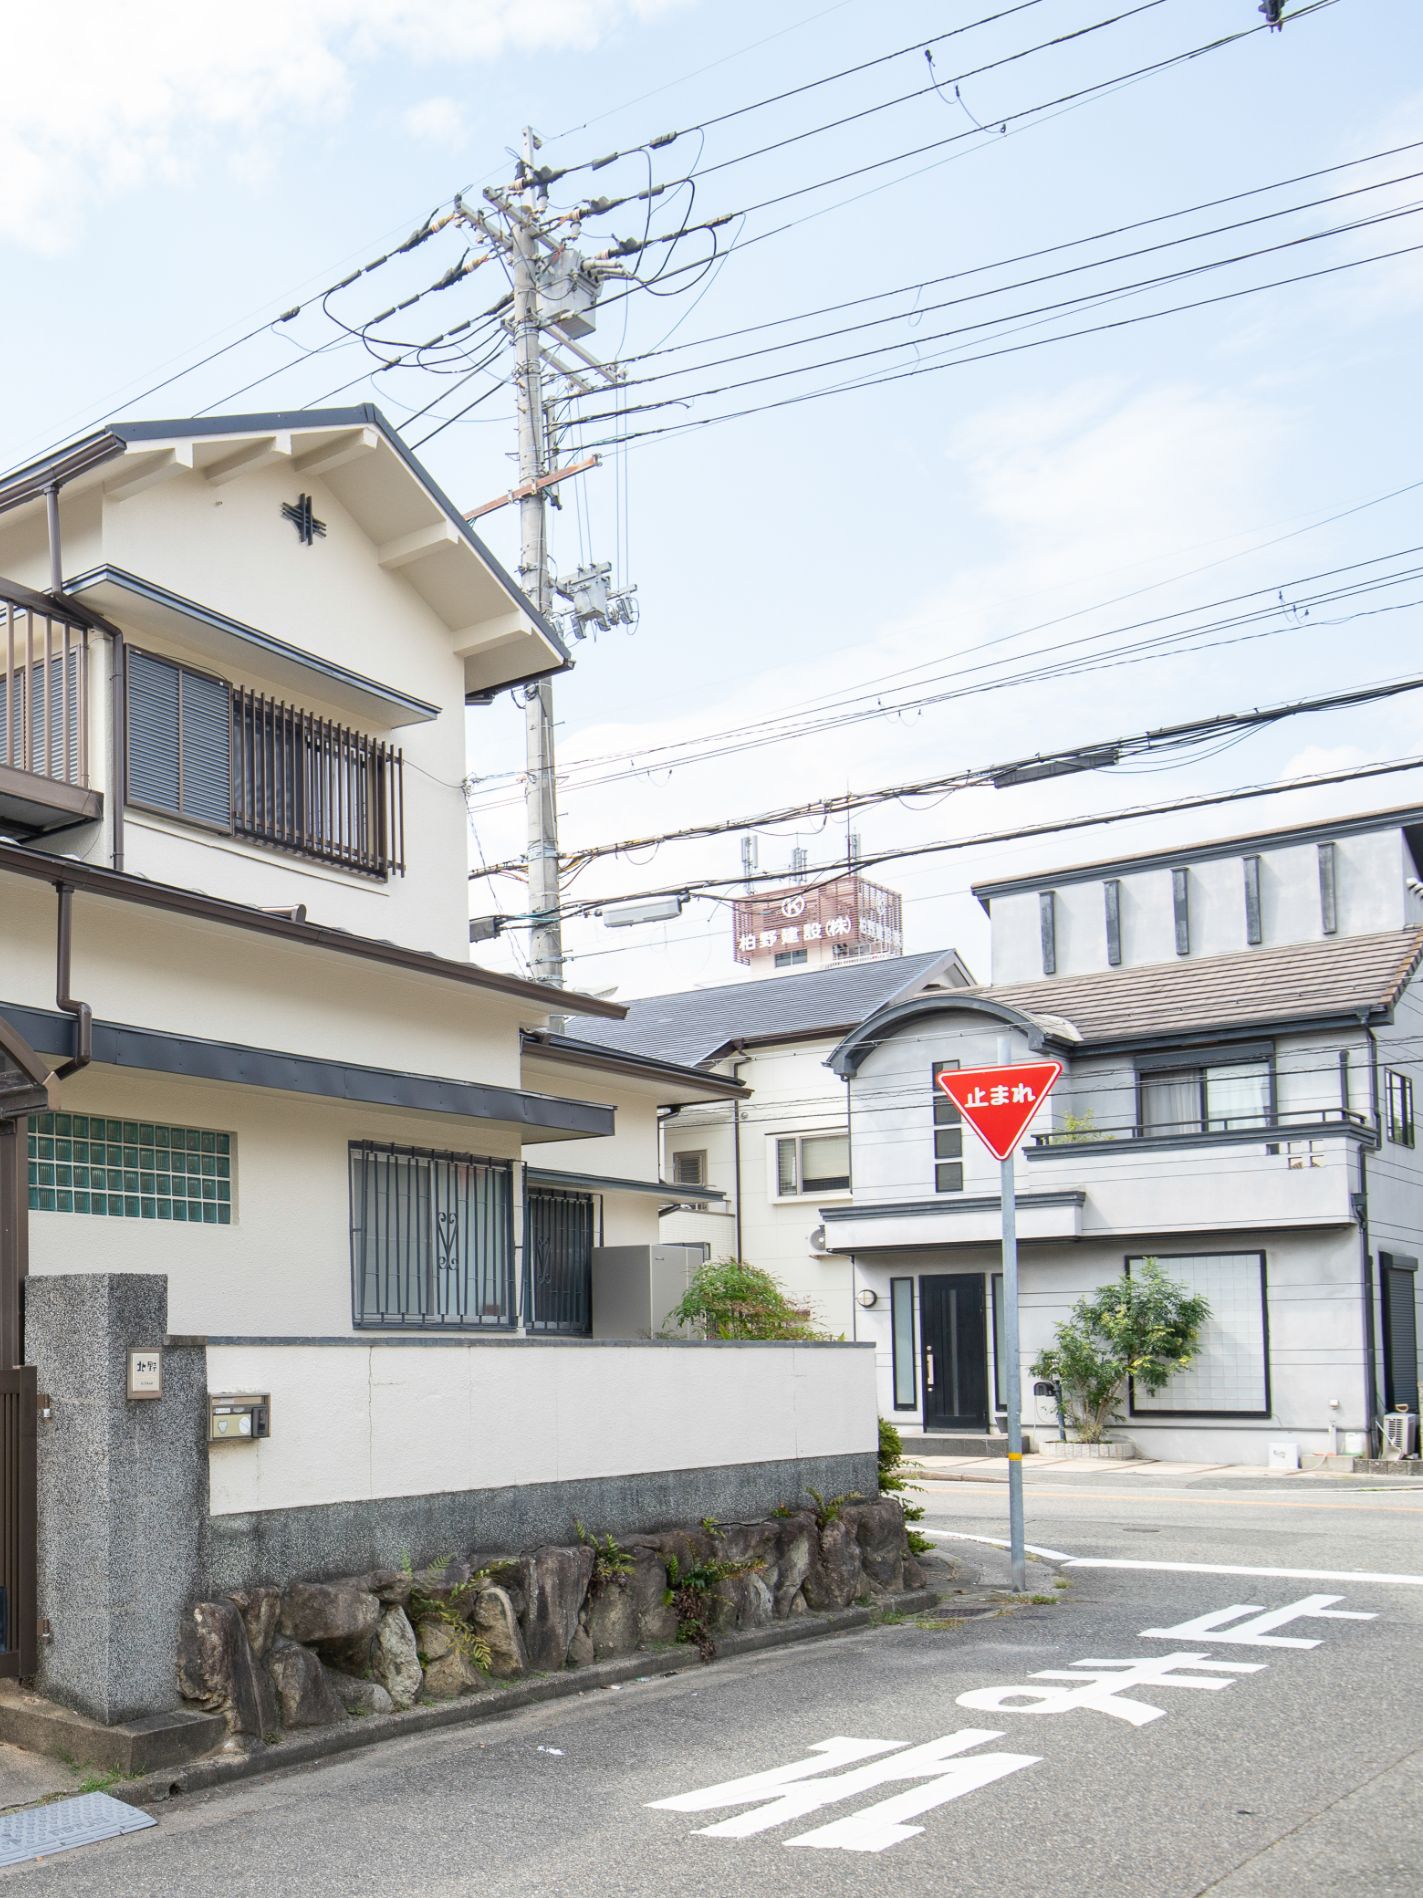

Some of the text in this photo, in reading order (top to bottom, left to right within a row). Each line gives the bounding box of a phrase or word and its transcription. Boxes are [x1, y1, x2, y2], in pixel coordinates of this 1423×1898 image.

[964, 1083, 1036, 1108] 止まれ
[644, 1594, 1379, 1852] 止まれ
